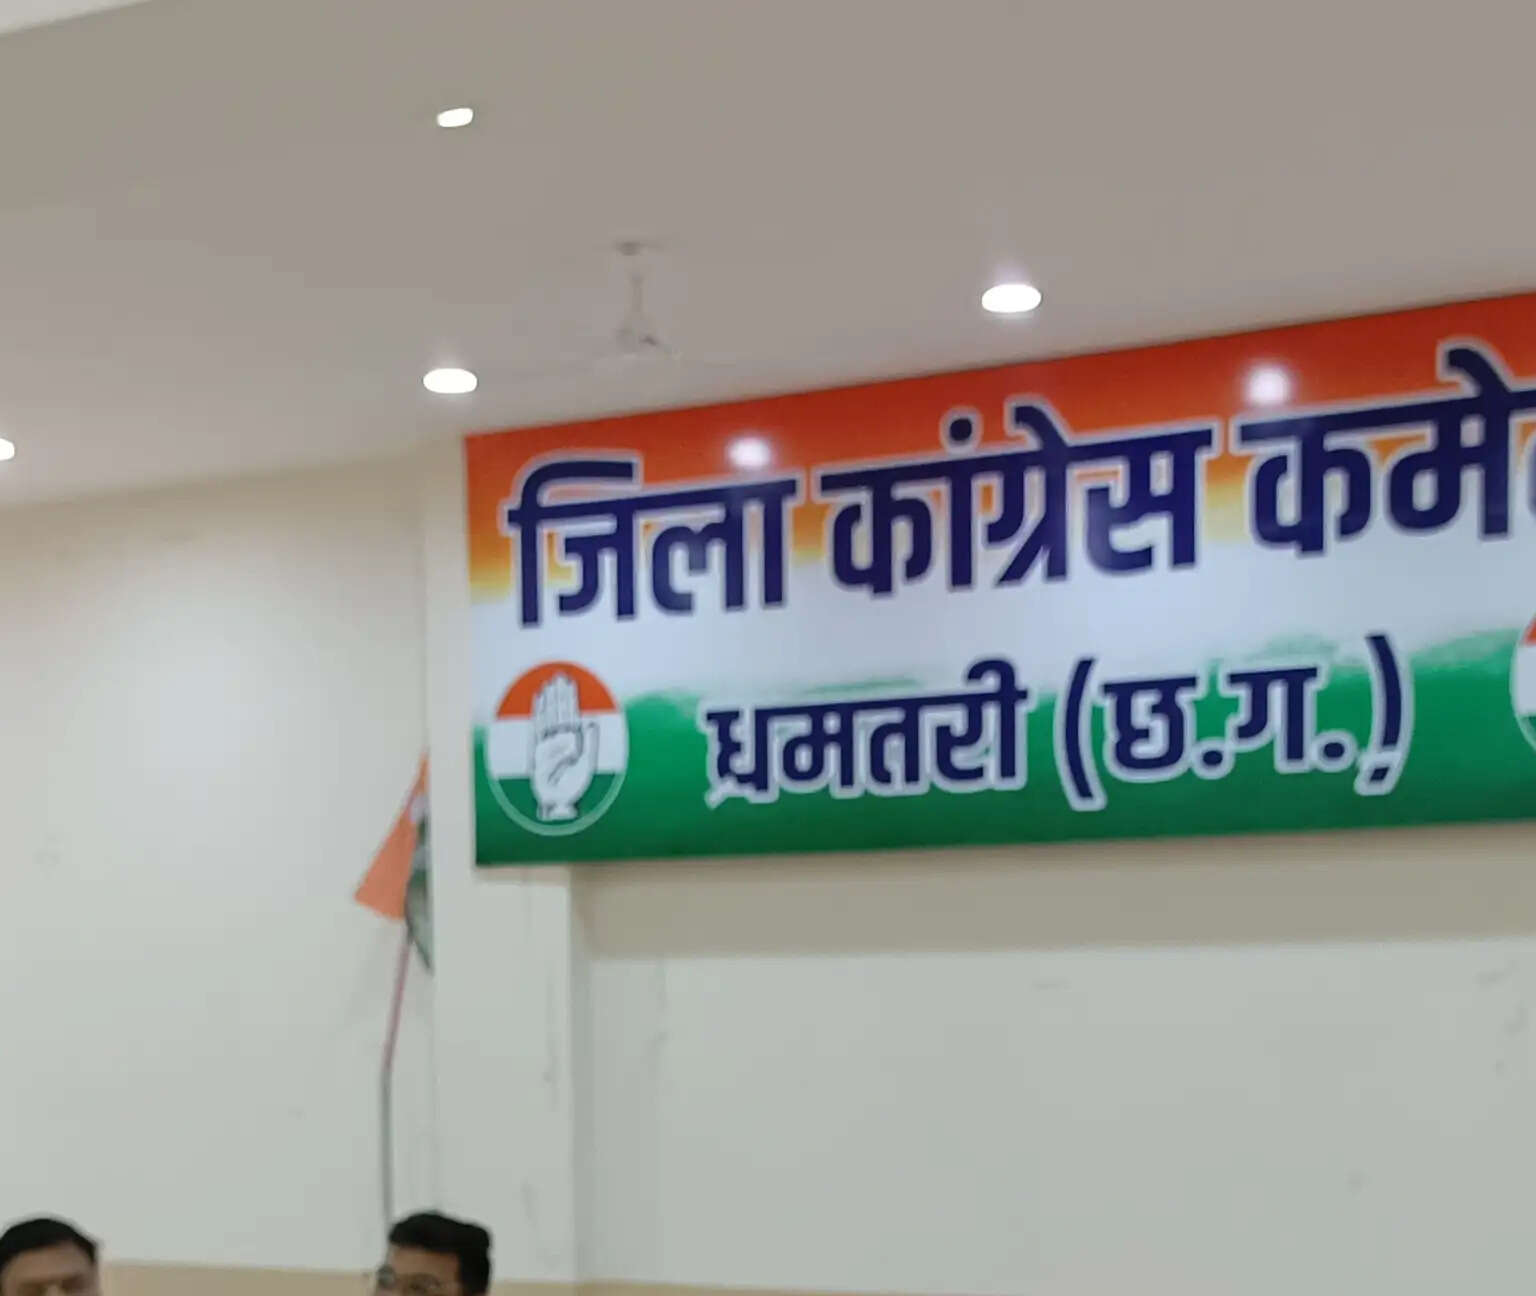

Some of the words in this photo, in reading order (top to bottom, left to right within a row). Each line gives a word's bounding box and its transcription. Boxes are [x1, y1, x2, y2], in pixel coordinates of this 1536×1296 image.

[506, 459, 798, 625] जिला
[819, 403, 1214, 595] कांग्रेस
[705, 658, 1029, 793] धमतरी
[1063, 633, 1403, 800] (छ.ग.)
